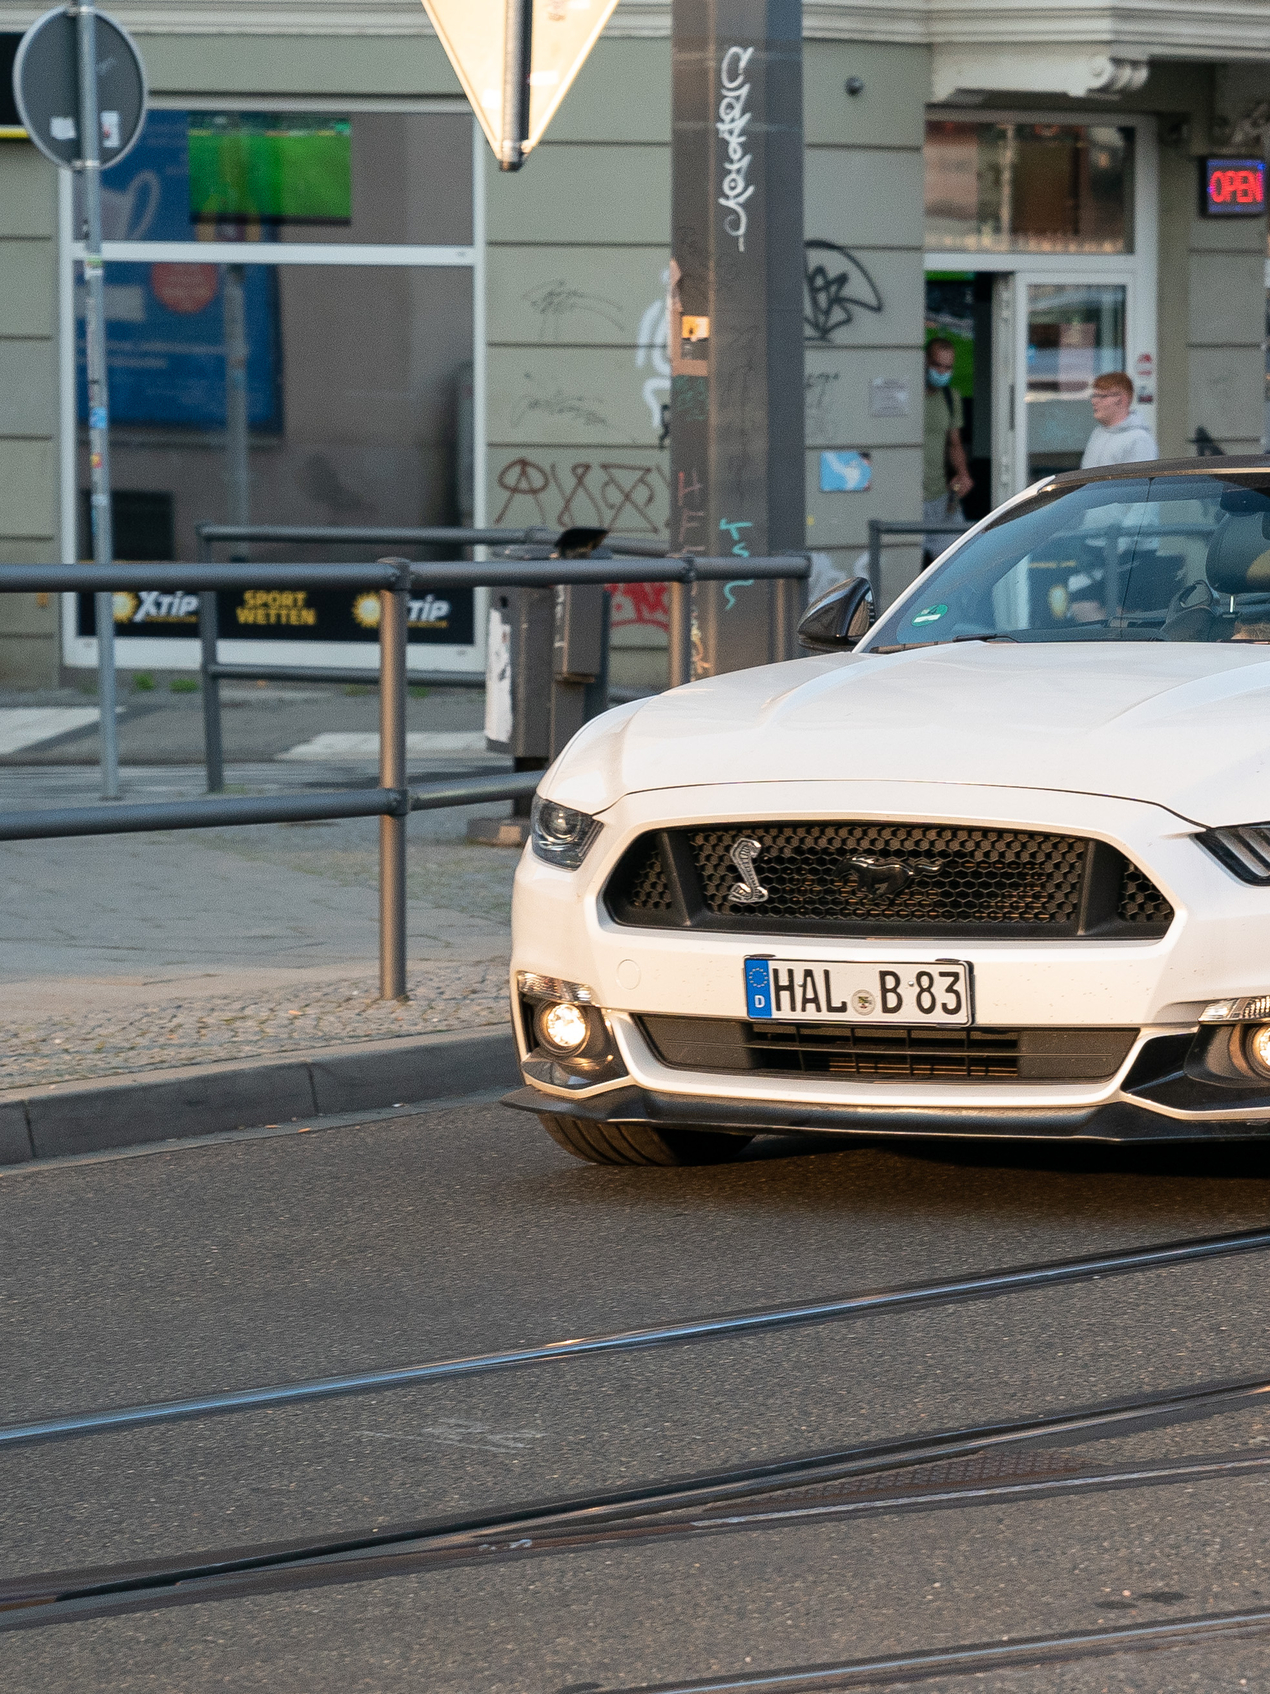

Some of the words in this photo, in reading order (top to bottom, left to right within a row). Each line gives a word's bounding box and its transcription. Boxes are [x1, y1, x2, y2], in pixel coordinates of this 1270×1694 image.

[1209, 171, 1263, 203] OPEN
[243, 590, 307, 607] SPORT
[236, 607, 316, 625] WETTEN
[772, 967, 848, 1013] HAL
[879, 970, 903, 1014] B
[916, 970, 962, 1016] 83
[754, 995, 765, 1008] D
